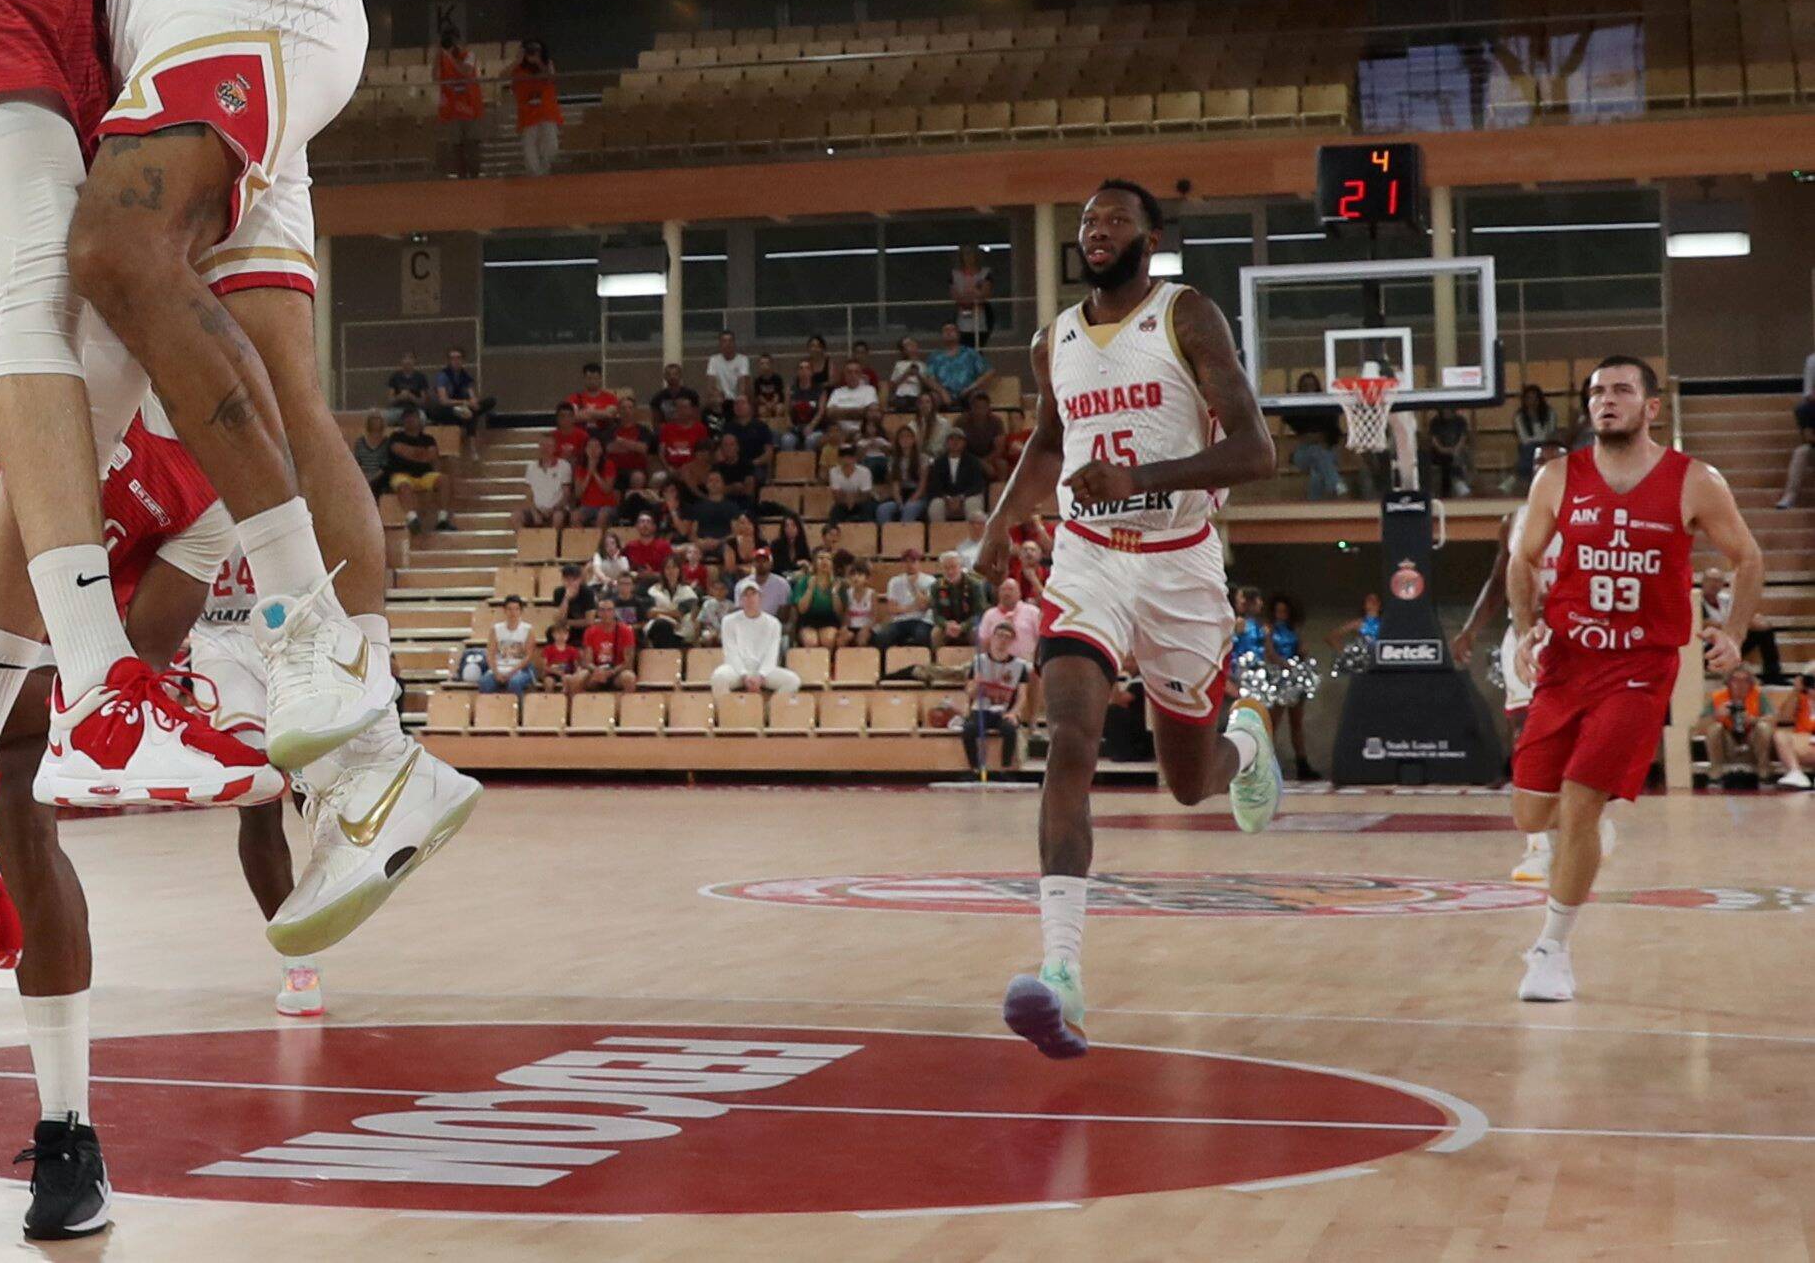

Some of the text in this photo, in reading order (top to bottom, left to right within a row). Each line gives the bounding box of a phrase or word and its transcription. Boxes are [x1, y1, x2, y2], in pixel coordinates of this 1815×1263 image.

[437, 5, 456, 34] K
[1371, 149, 1390, 173] 4
[1338, 179, 1400, 219] 21
[411, 250, 431, 281] C
[1064, 381, 1163, 421] MONACO
[1569, 507, 1600, 525] AIN
[1577, 544, 1662, 575] BOURG
[212, 555, 256, 598] 24
[1589, 574, 1642, 613] 83
[1381, 644, 1437, 661] Betclic
